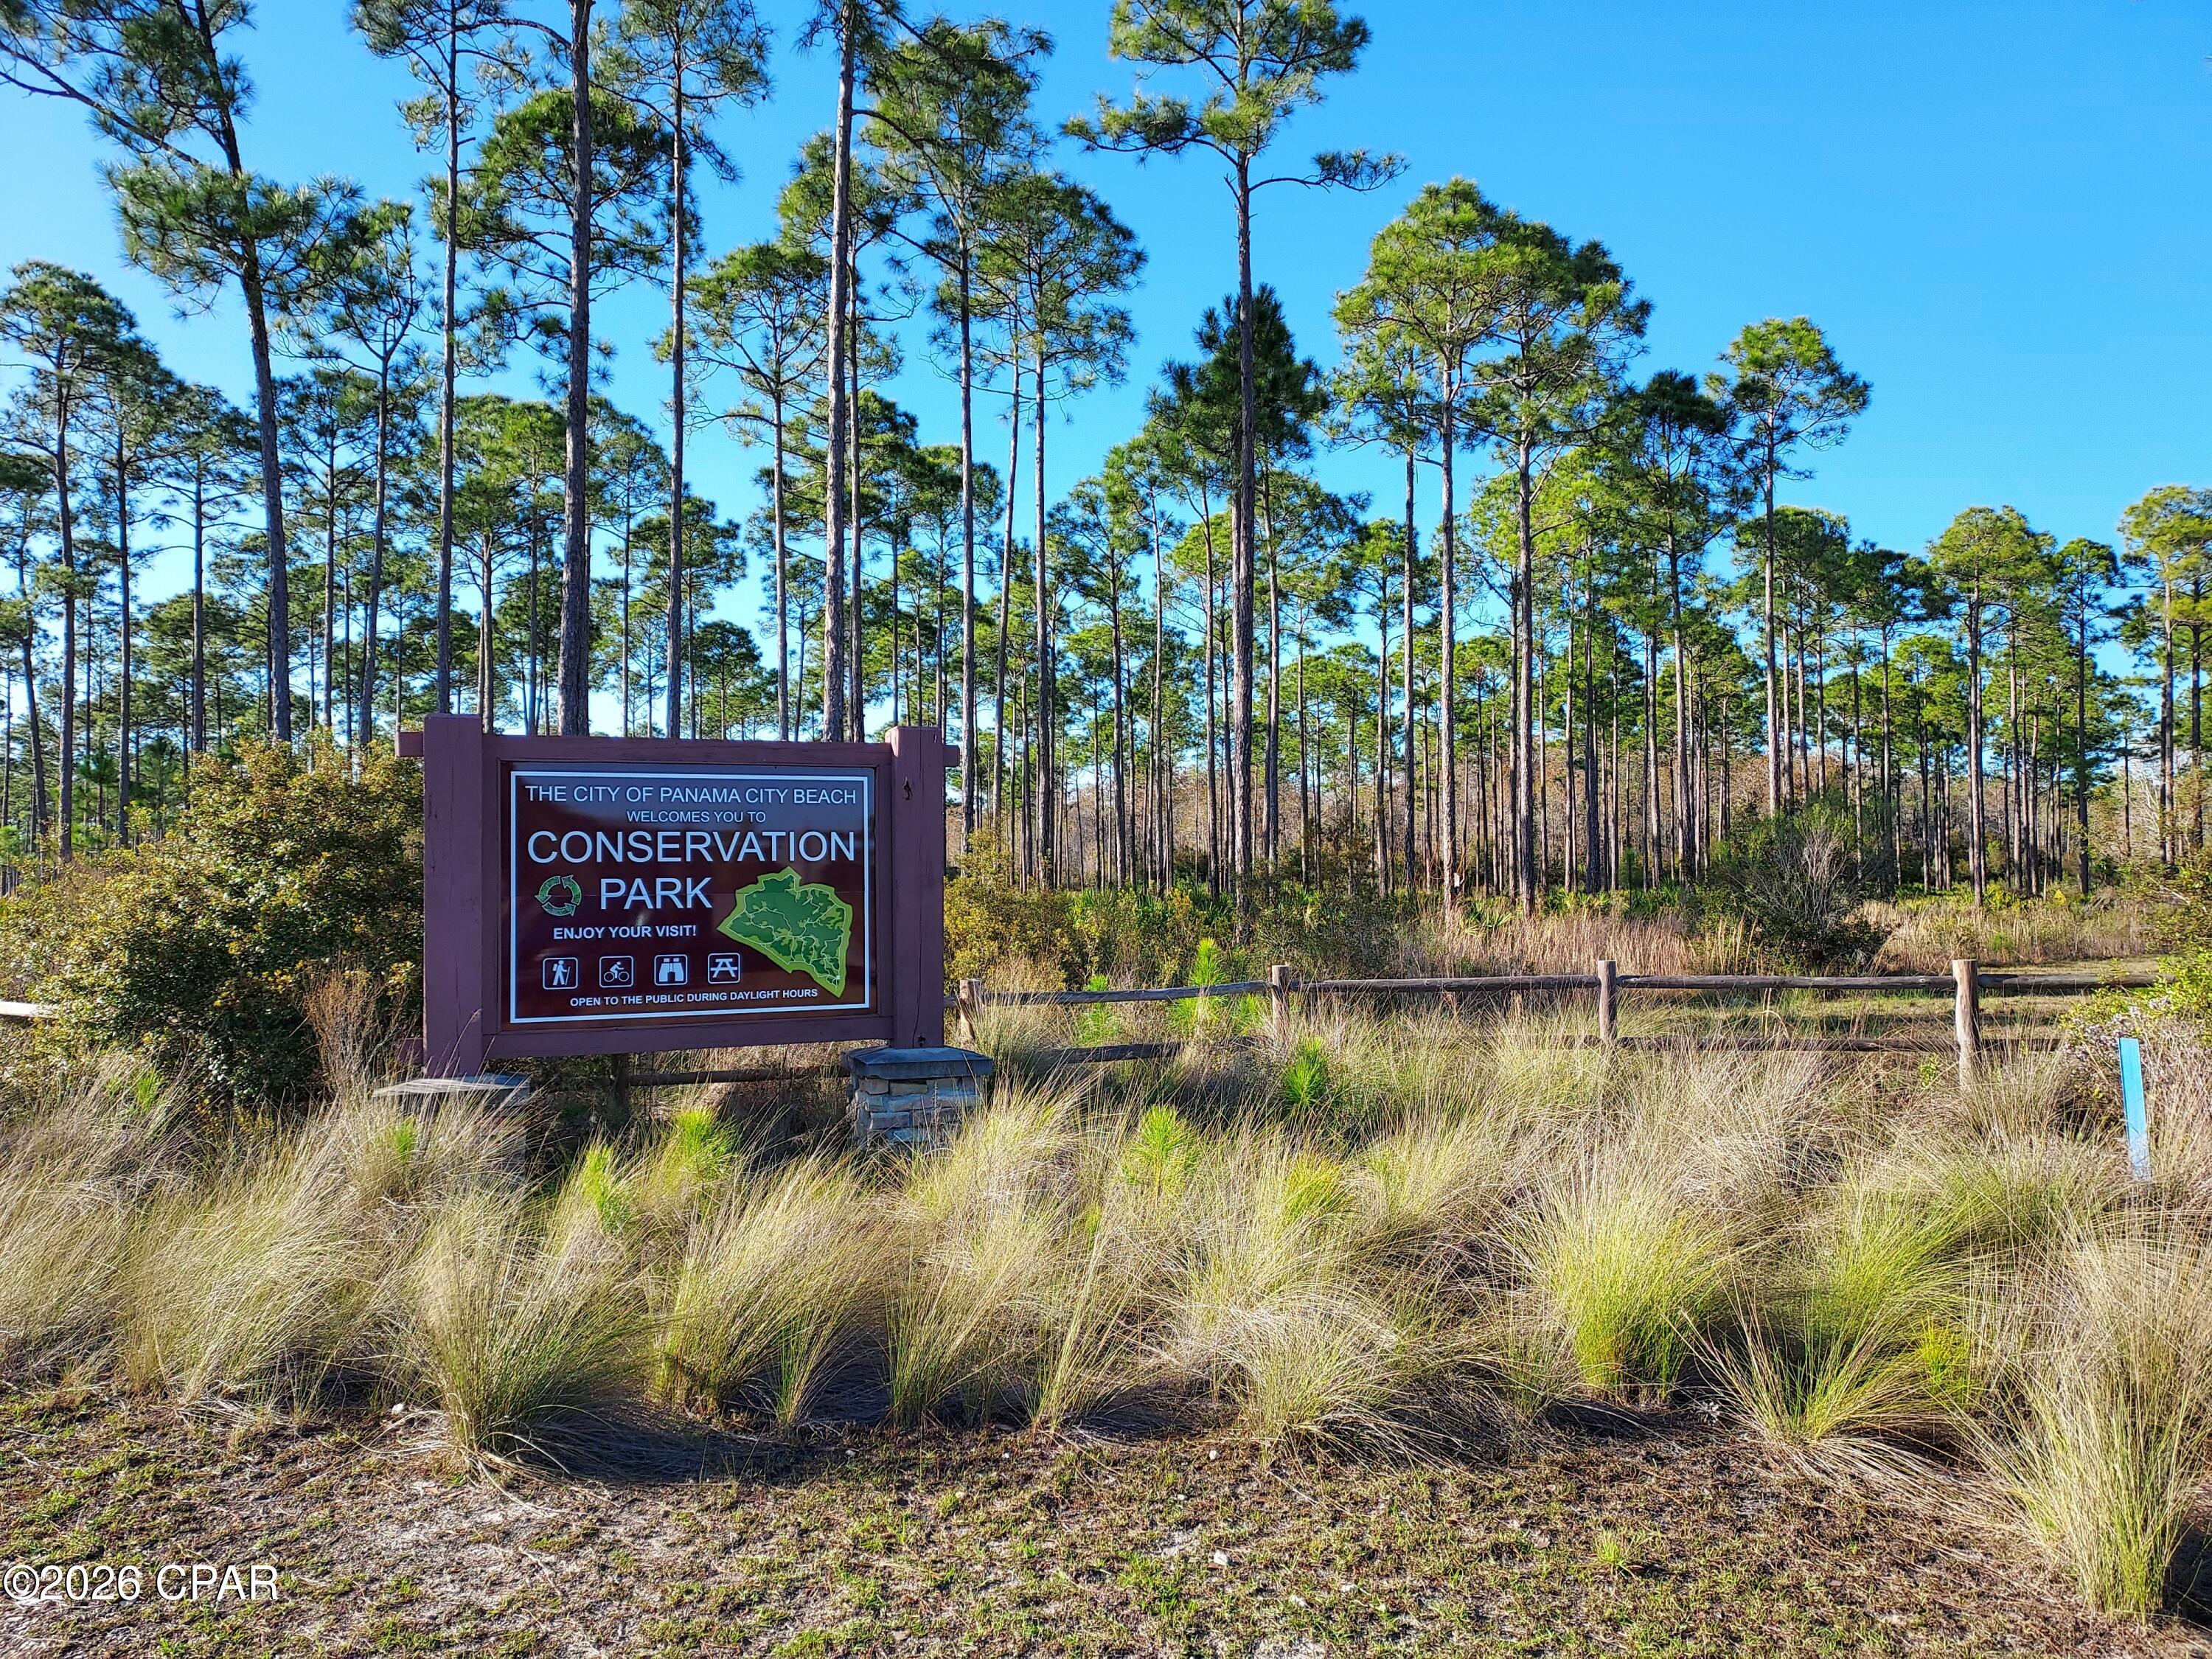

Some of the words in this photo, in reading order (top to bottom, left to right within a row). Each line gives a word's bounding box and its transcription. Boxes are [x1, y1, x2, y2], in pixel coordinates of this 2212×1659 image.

[524, 785, 567, 801] THE
[574, 786, 621, 802] CITY
[626, 787, 654, 802] OF
[660, 787, 742, 803] PANAMA
[745, 788, 788, 804] CITY
[793, 789, 856, 804] BEACH
[626, 810, 710, 823] WELCOMES
[713, 811, 743, 823] YOU
[747, 811, 766, 823] TO
[527, 830, 855, 863] CONSERVATION
[600, 877, 713, 910] PARK
[553, 926, 604, 939] ENJOY
[608, 925, 652, 938] YOUR
[655, 925, 696, 937] VISIT!
[570, 997, 601, 1006] OPEN
[603, 996, 619, 1006] TO
[621, 995, 643, 1005] THE
[645, 993, 684, 1004] PUBLIC
[686, 992, 728, 1002] DURING
[730, 990, 781, 1001] DAYLIGHT
[782, 988, 818, 998] HOURS
